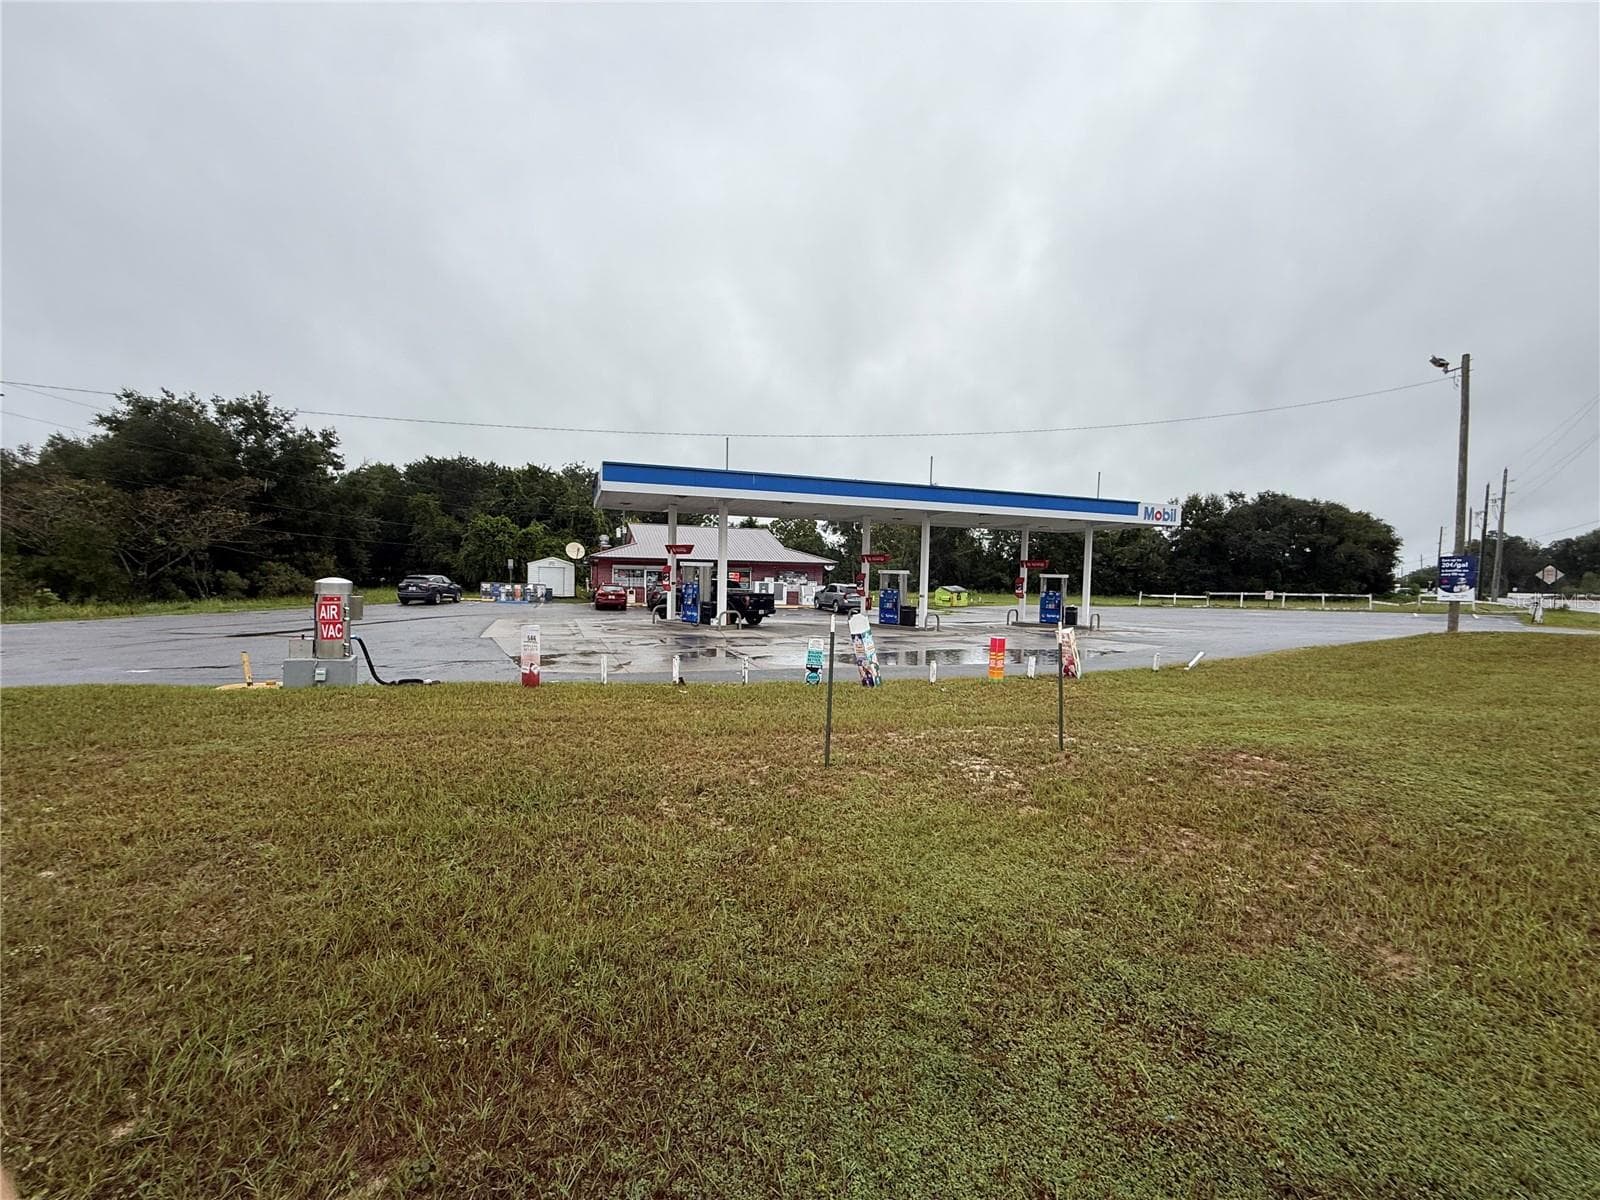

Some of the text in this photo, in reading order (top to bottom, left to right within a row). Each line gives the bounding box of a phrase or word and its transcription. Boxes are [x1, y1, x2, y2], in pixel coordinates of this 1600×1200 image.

[1144, 506, 1176, 522] Mobil
[319, 605, 338, 620] AIR
[321, 623, 342, 638] VAC
